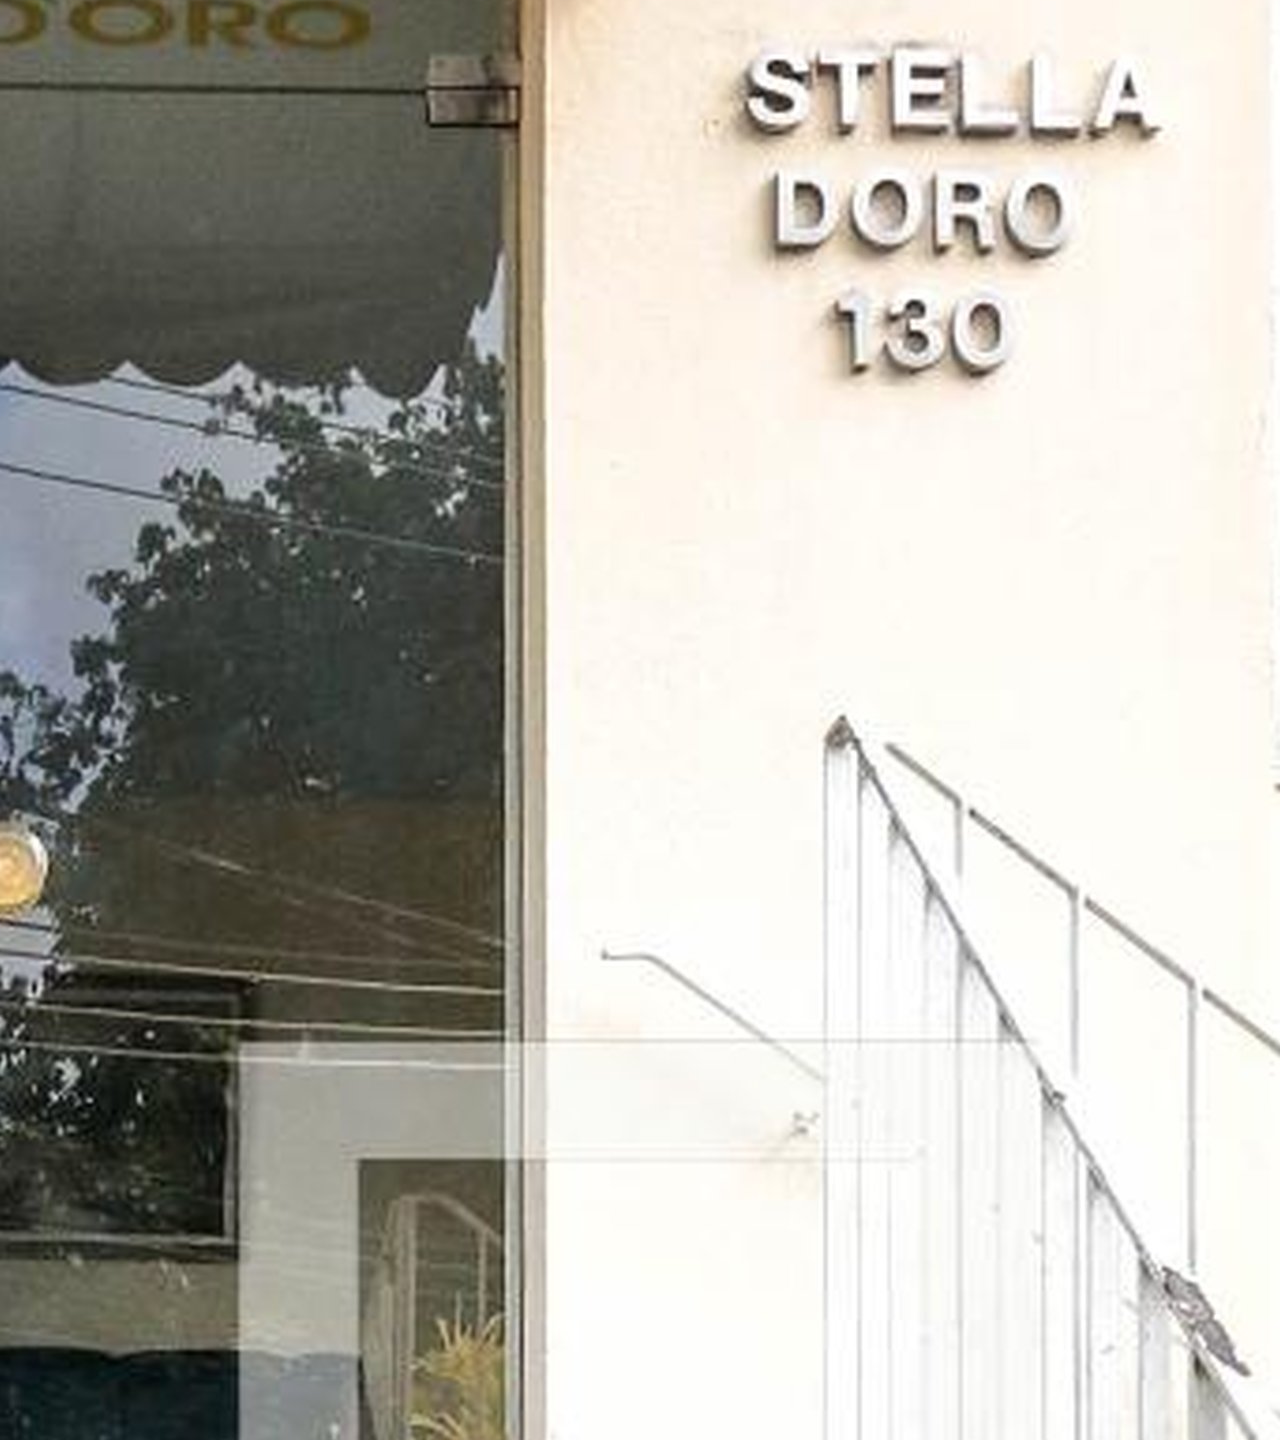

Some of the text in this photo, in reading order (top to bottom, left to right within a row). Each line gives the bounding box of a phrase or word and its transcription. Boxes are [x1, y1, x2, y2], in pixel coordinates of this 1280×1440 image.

[745, 44, 1161, 139] STELLA
[773, 169, 1072, 257] DORO
[834, 287, 1018, 375] 130
